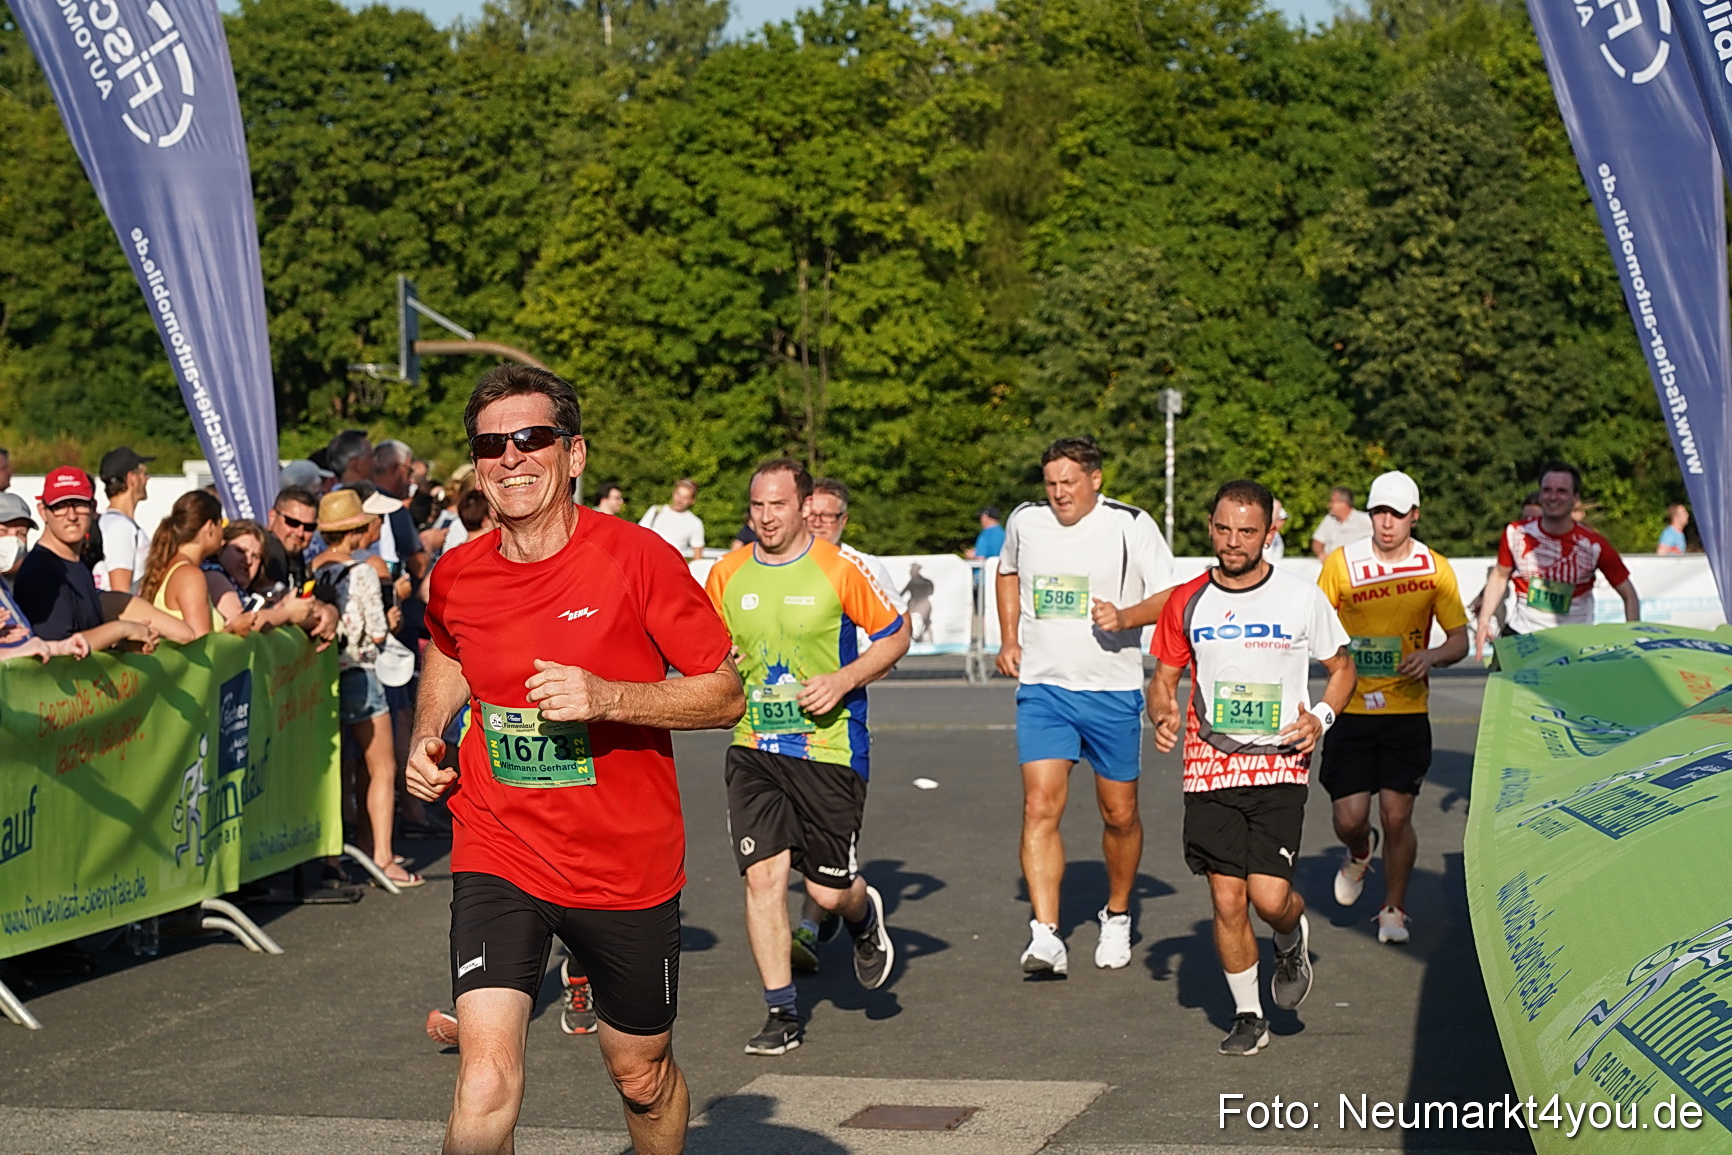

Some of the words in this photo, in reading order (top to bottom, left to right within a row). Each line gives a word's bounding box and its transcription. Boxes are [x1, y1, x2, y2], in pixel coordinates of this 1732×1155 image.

[1044, 589, 1075, 605] 586
[1352, 586, 1391, 605] MAX
[1396, 579, 1437, 596] BÖGL
[1356, 650, 1393, 665] 1636
[763, 700, 794, 718] 631
[1230, 699, 1264, 718] 341
[503, 722, 536, 730] Firmenlauf
[490, 740, 502, 767] RUN
[499, 733, 572, 762] 1673
[573, 738, 589, 774] 2022
[500, 760, 538, 773] Wittmann
[539, 761, 578, 773] Gerhard
[1226, 754, 1269, 771] AVIA
[1210, 771, 1253, 791] AVIA
[1253, 767, 1296, 786] AVIA
[1566, 773, 1719, 837] firmenlauf
[1588, 1051, 1660, 1116] neumarkt
